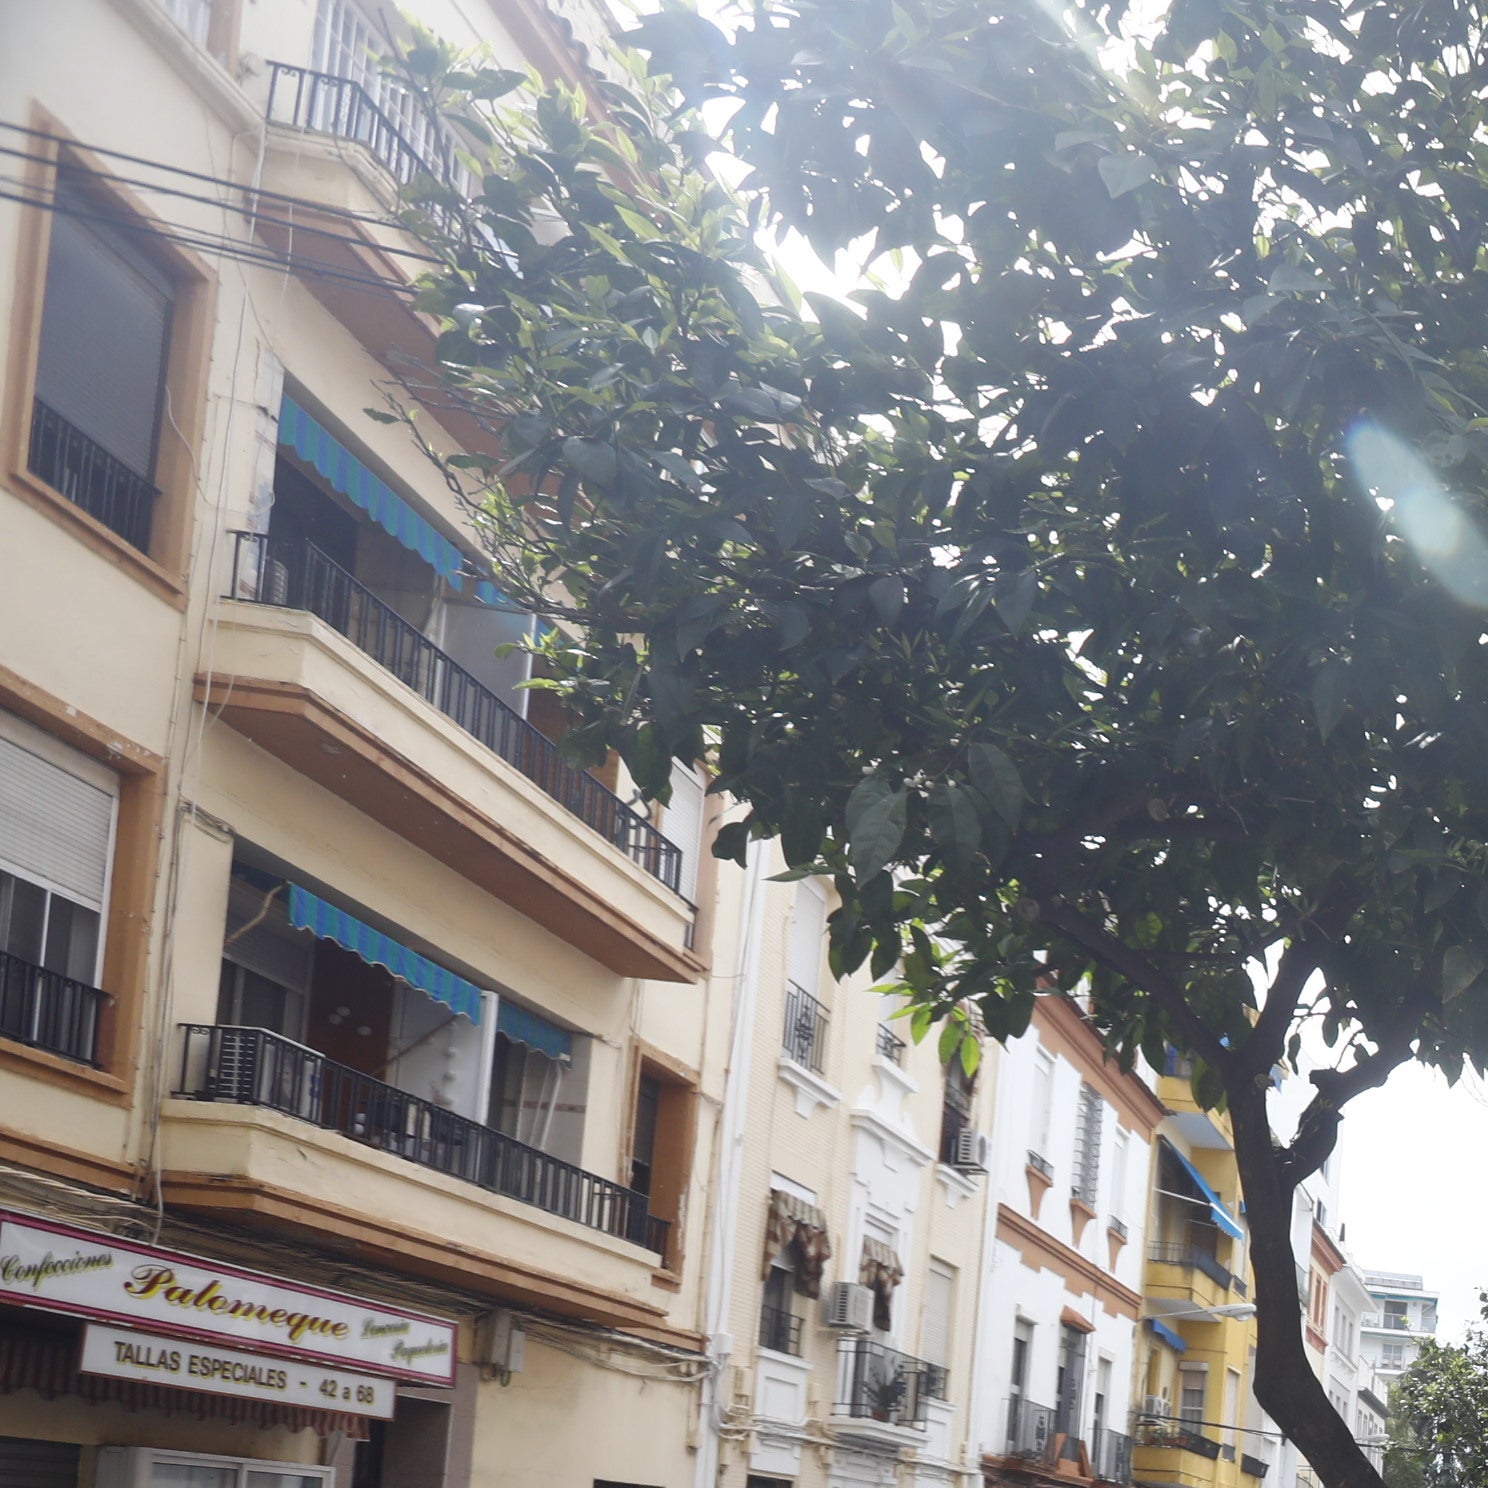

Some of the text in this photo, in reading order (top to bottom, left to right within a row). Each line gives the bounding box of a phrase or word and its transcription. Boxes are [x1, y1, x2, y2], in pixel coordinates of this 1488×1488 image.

[124, 1264, 351, 1342] Palomeque
[114, 1341, 375, 1404] TALLAS ESPECIALES 42 a 68
